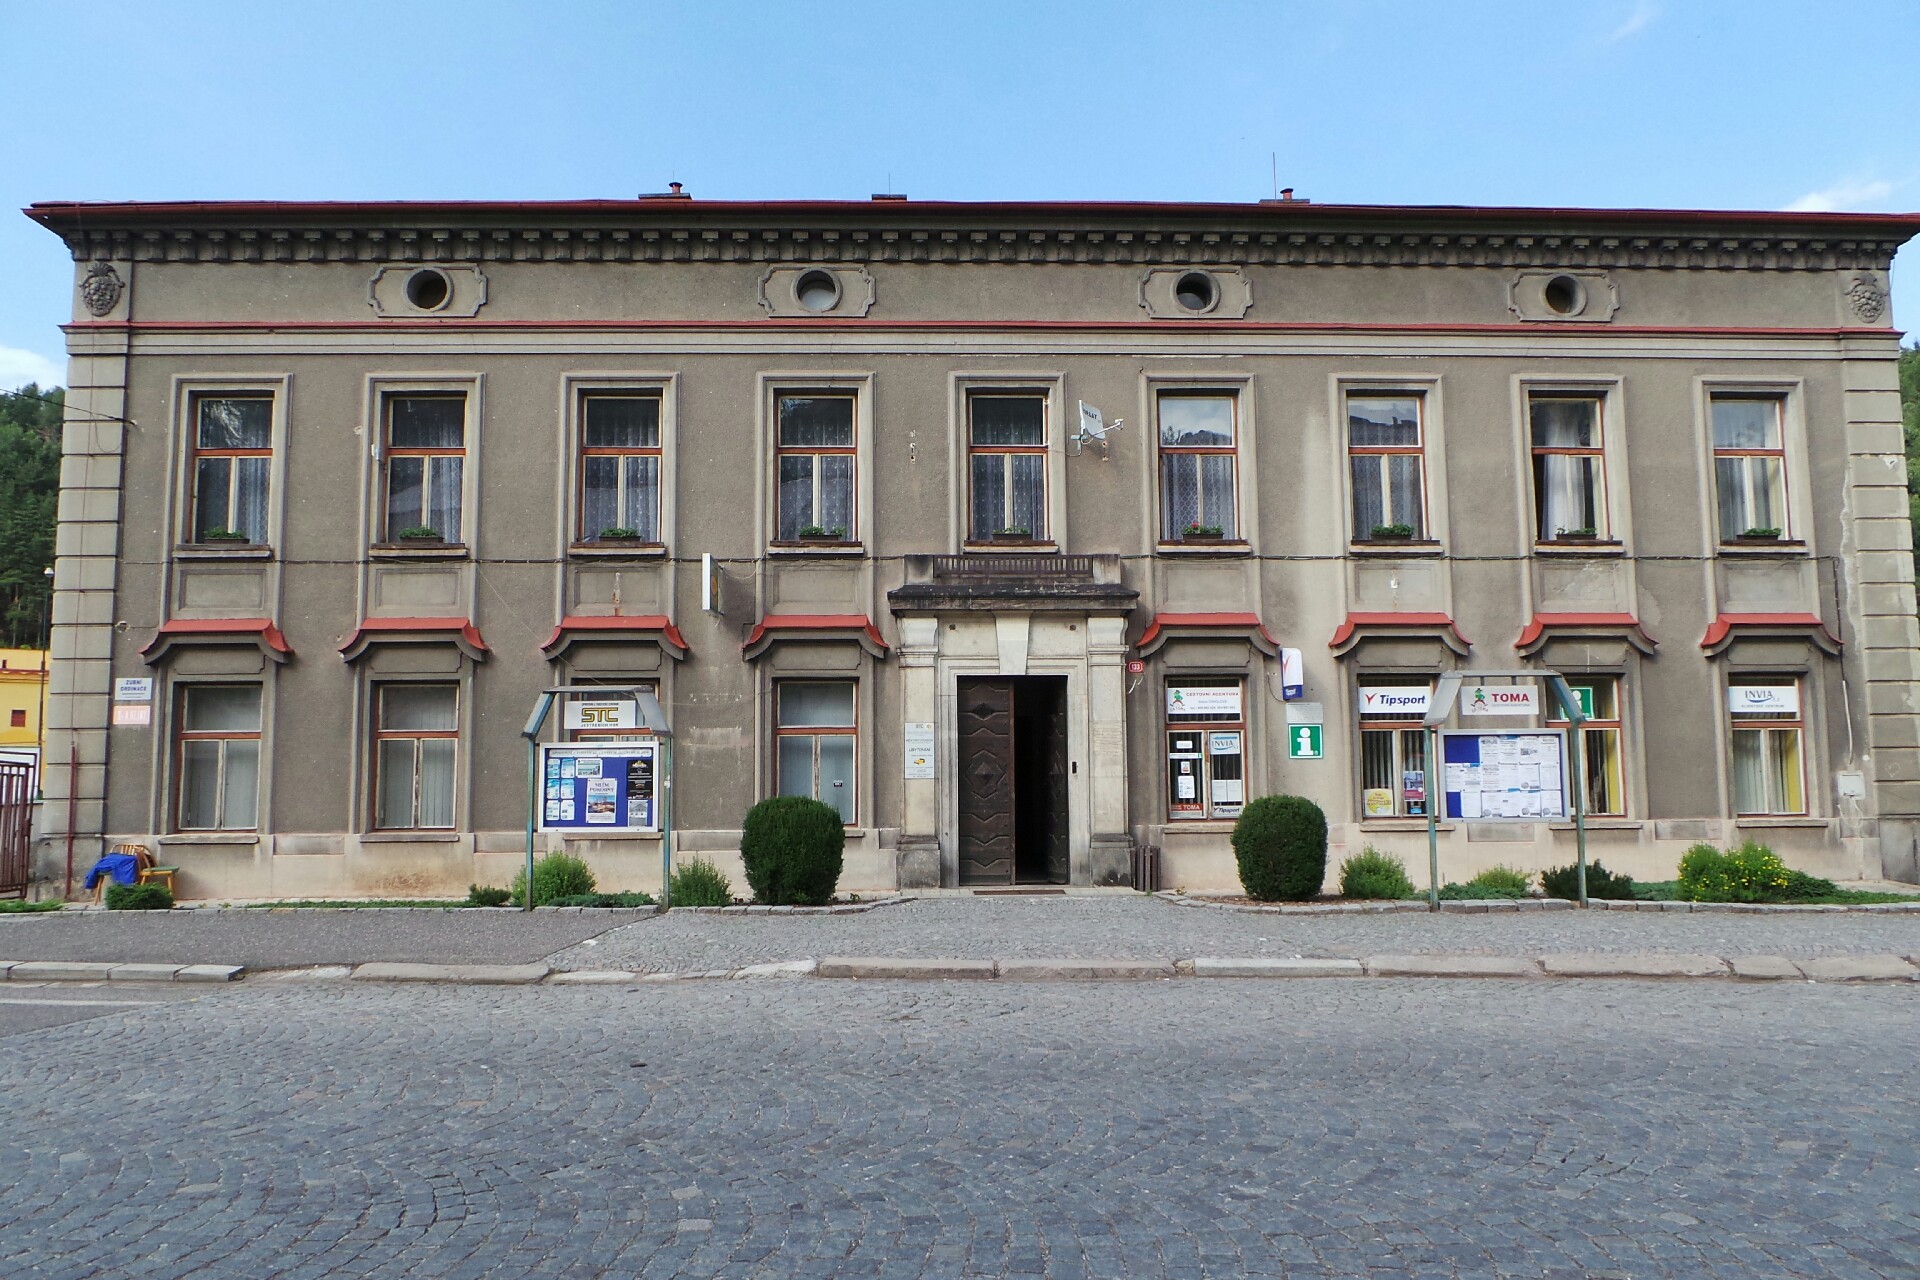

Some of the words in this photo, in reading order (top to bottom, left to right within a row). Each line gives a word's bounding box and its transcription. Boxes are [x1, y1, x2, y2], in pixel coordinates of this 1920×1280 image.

[1491, 693, 1529, 702] TOMA
[1745, 690, 1774, 699] INVIA
[1380, 694, 1426, 707] Tipsport
[581, 707, 619, 723] STC
[1211, 739, 1234, 747] INVIA
